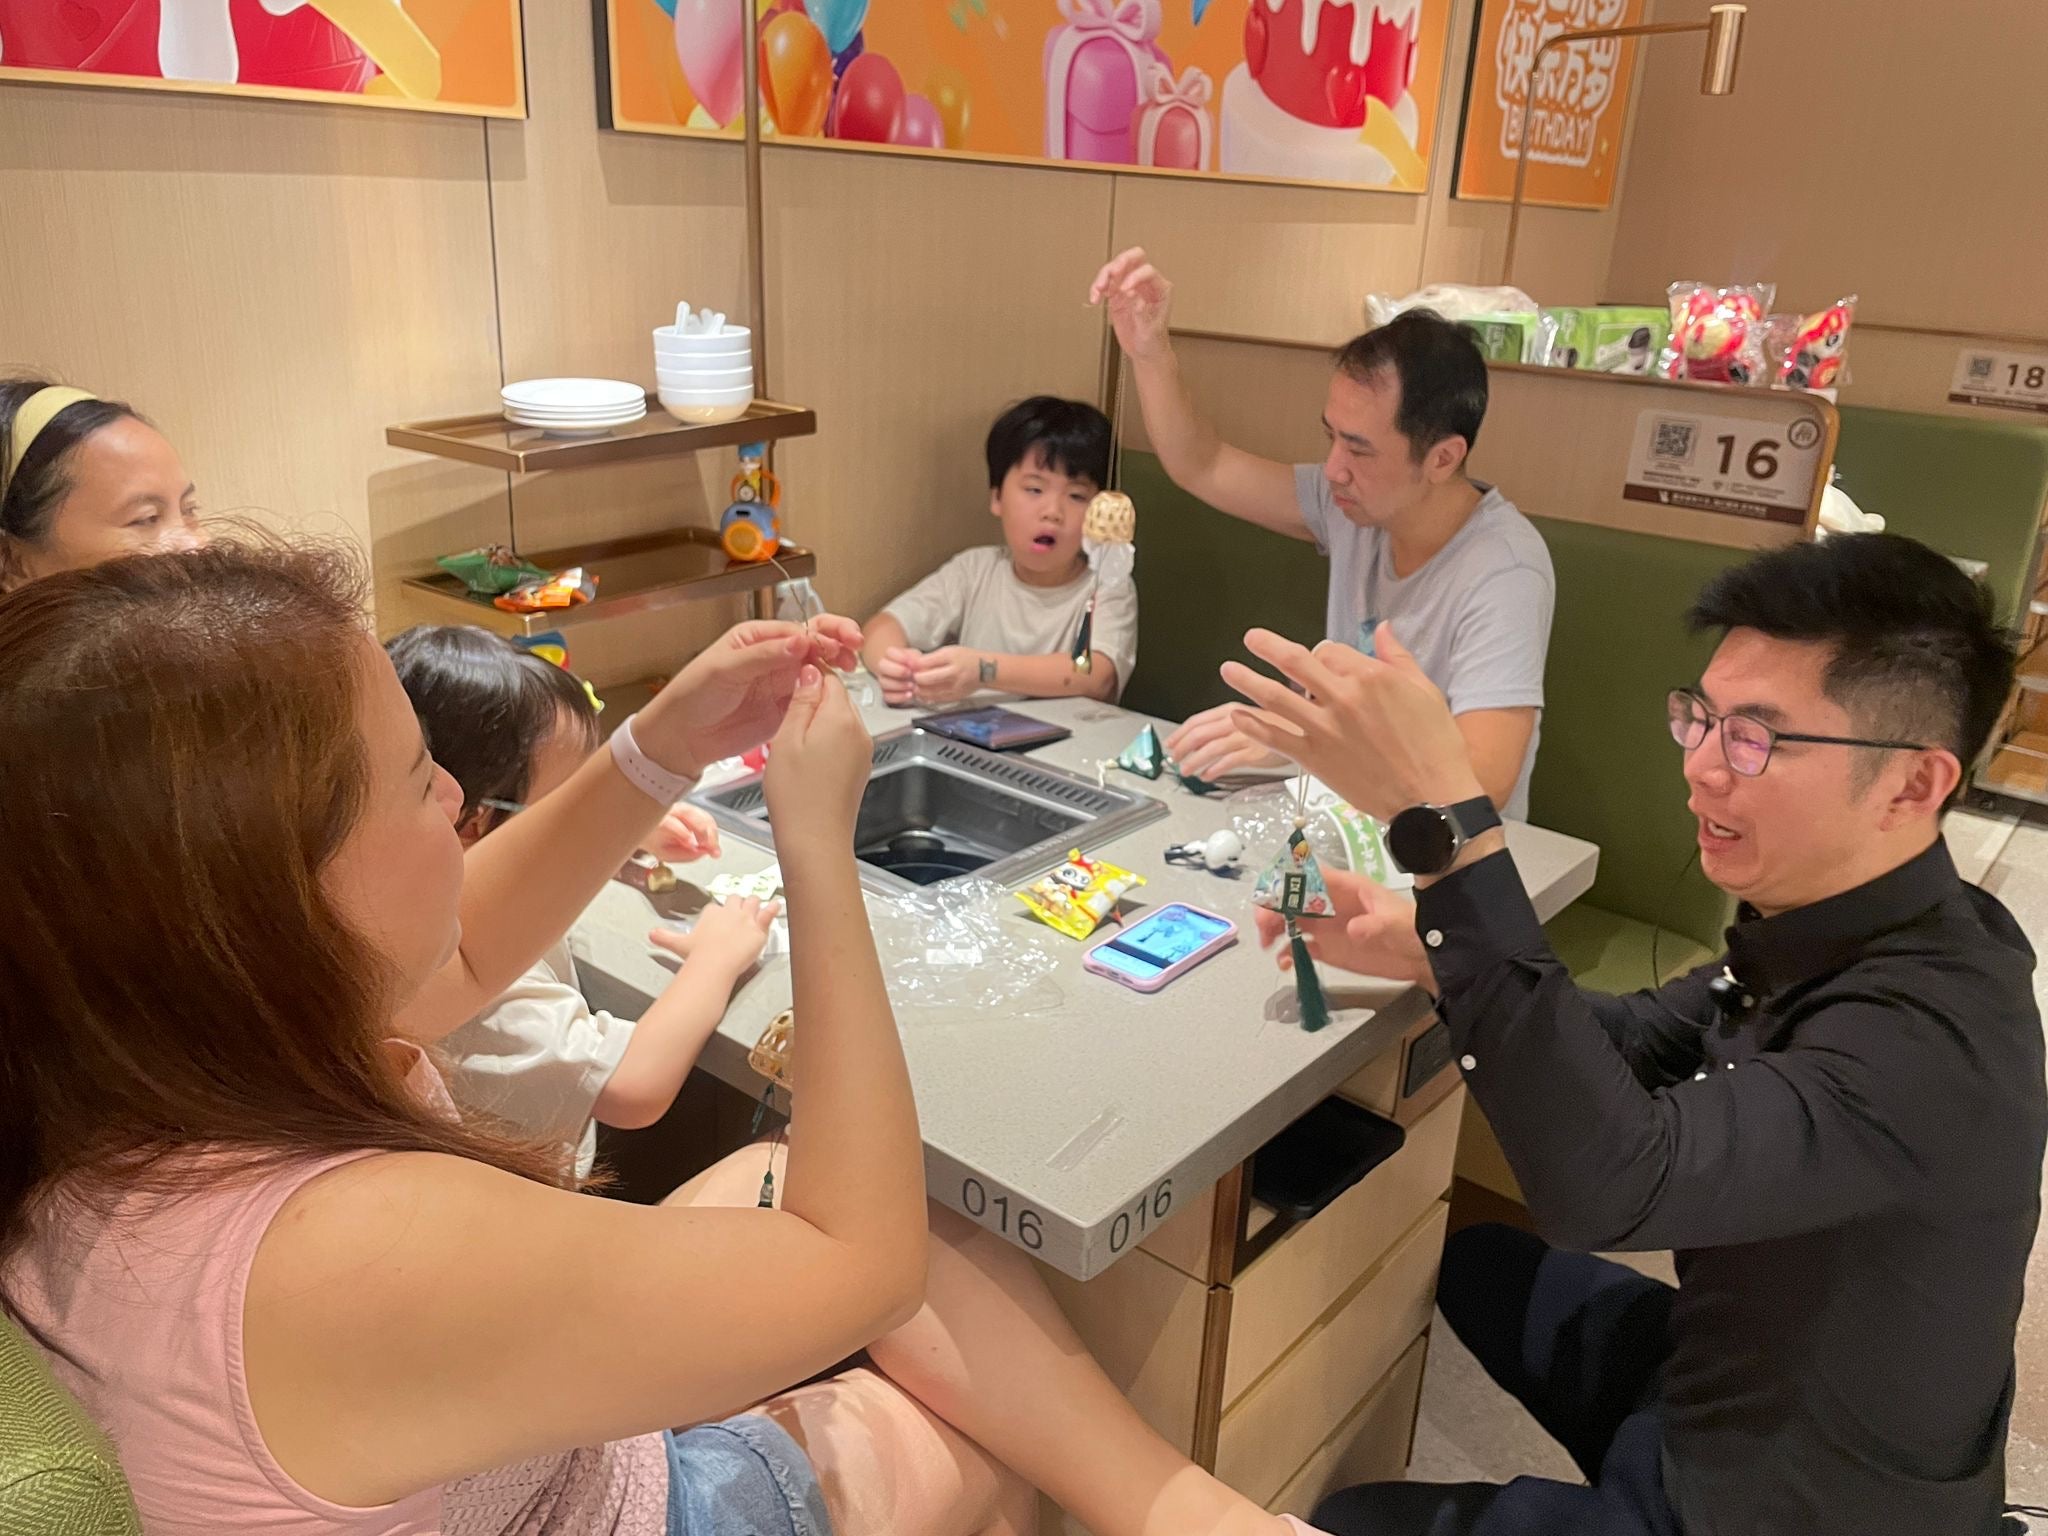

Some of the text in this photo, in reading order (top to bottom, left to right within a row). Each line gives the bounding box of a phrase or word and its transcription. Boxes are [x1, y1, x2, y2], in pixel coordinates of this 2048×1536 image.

[2007, 363, 2046, 389] 18
[1717, 434, 1781, 480] 16
[962, 1178, 1043, 1249] 016
[1110, 1178, 1172, 1253] 016
